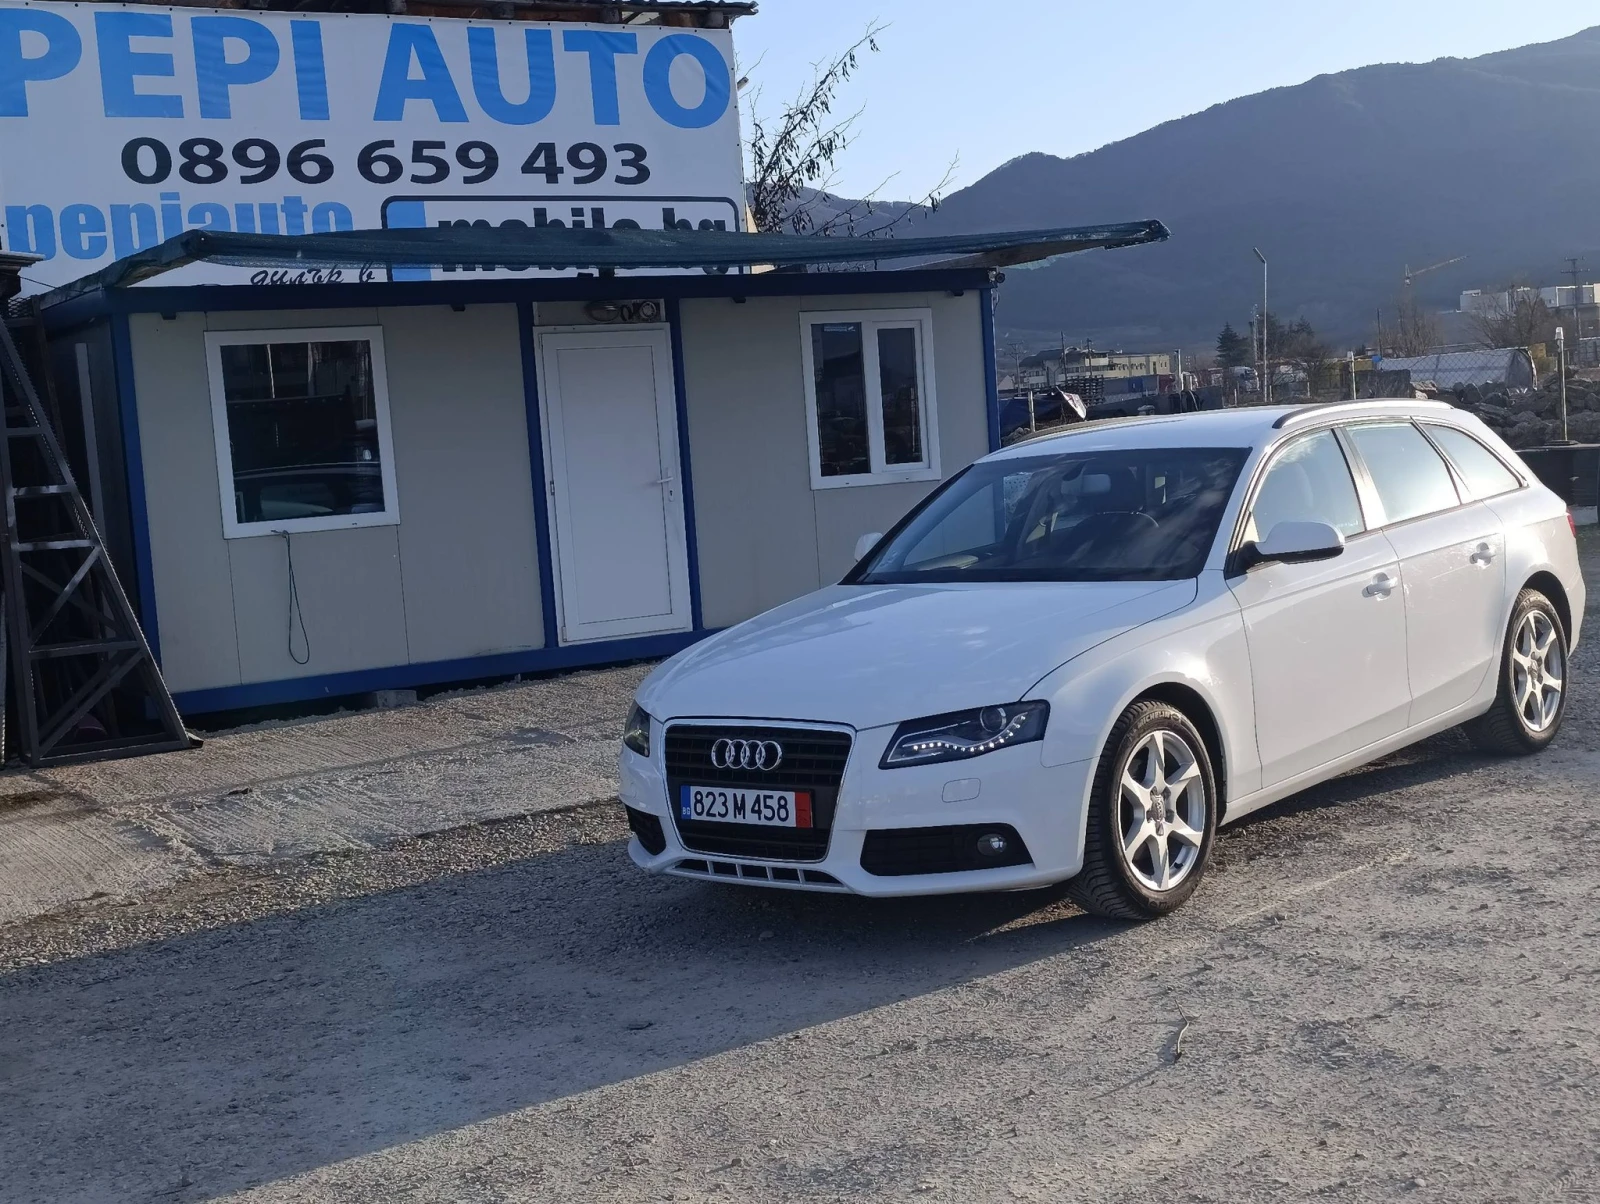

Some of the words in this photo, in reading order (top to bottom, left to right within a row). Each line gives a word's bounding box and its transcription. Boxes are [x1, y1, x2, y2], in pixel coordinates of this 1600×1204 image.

[0, 8, 330, 120] PEPI
[373, 23, 731, 129] AUTO
[121, 136, 335, 185] 0896
[357, 139, 499, 185] 659
[520, 141, 651, 185] 493
[682, 806, 691, 816] BG
[693, 790, 729, 818] 823
[732, 792, 746, 820] M
[750, 793, 790, 822] 458
